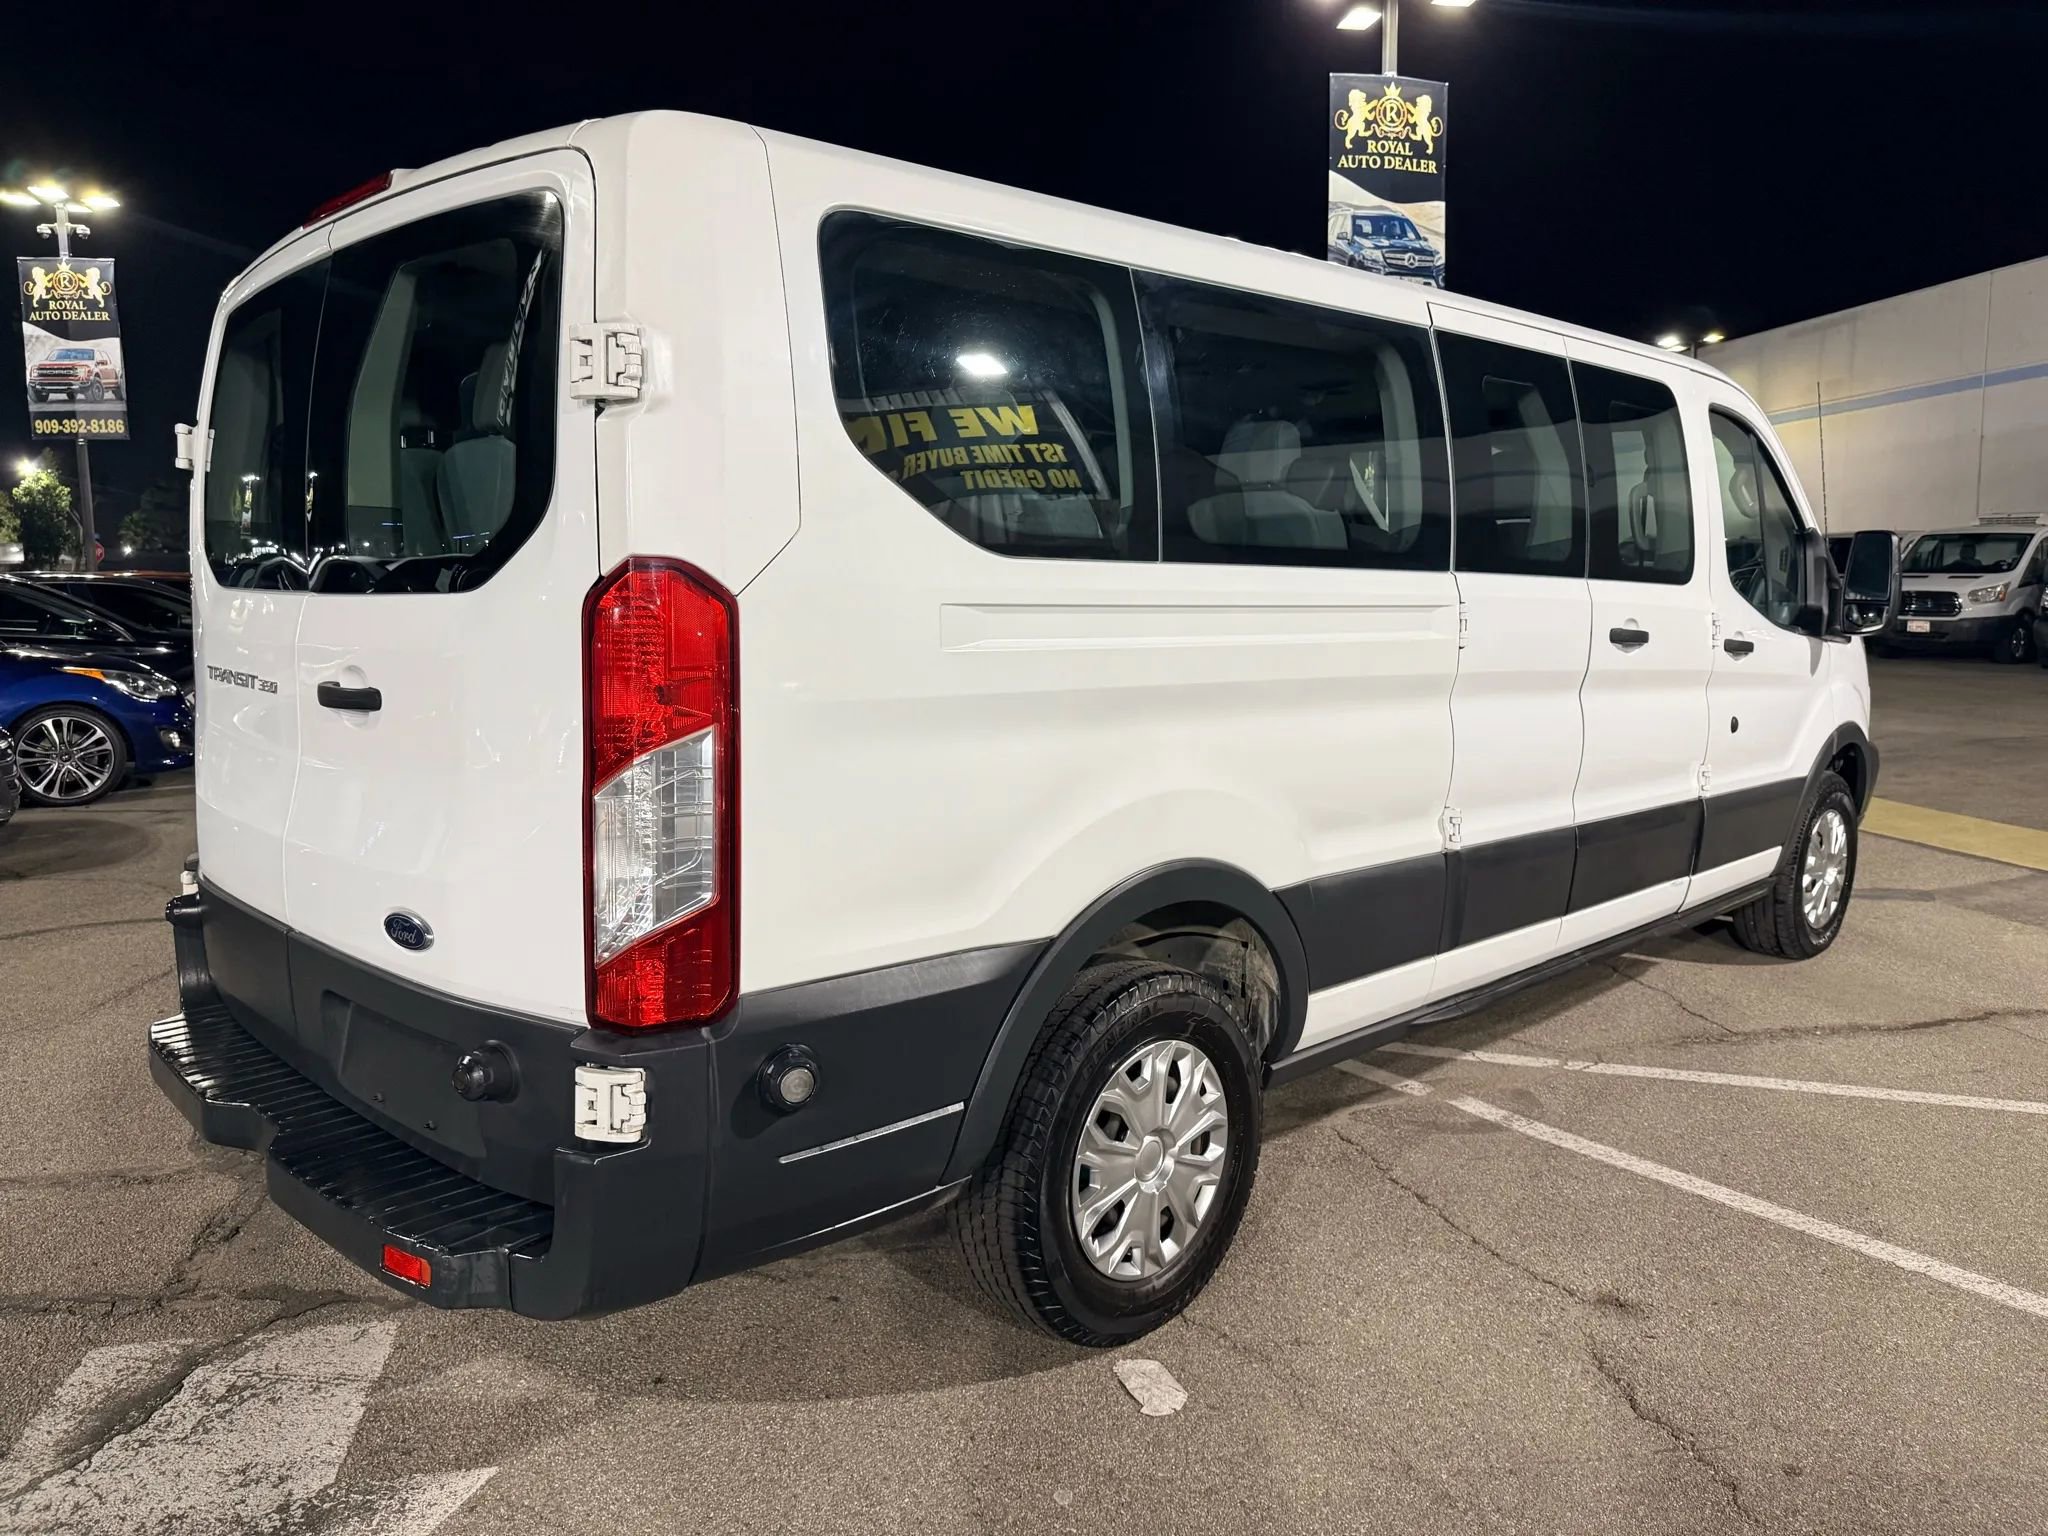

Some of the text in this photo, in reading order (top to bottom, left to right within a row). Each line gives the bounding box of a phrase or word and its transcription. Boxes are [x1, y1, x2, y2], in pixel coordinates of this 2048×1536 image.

[1385, 103, 1399, 122] R
[1367, 140, 1414, 157] ROYAL
[1337, 155, 1438, 174] AUTO DEALER
[59, 276, 70, 289] R
[48, 300, 87, 310] ROYAL
[29, 311, 111, 321] AUTO DEALER
[34, 419, 125, 434] 909-392-8186
[207, 665, 259, 690] TRANSIT
[390, 918, 418, 944] Ford
